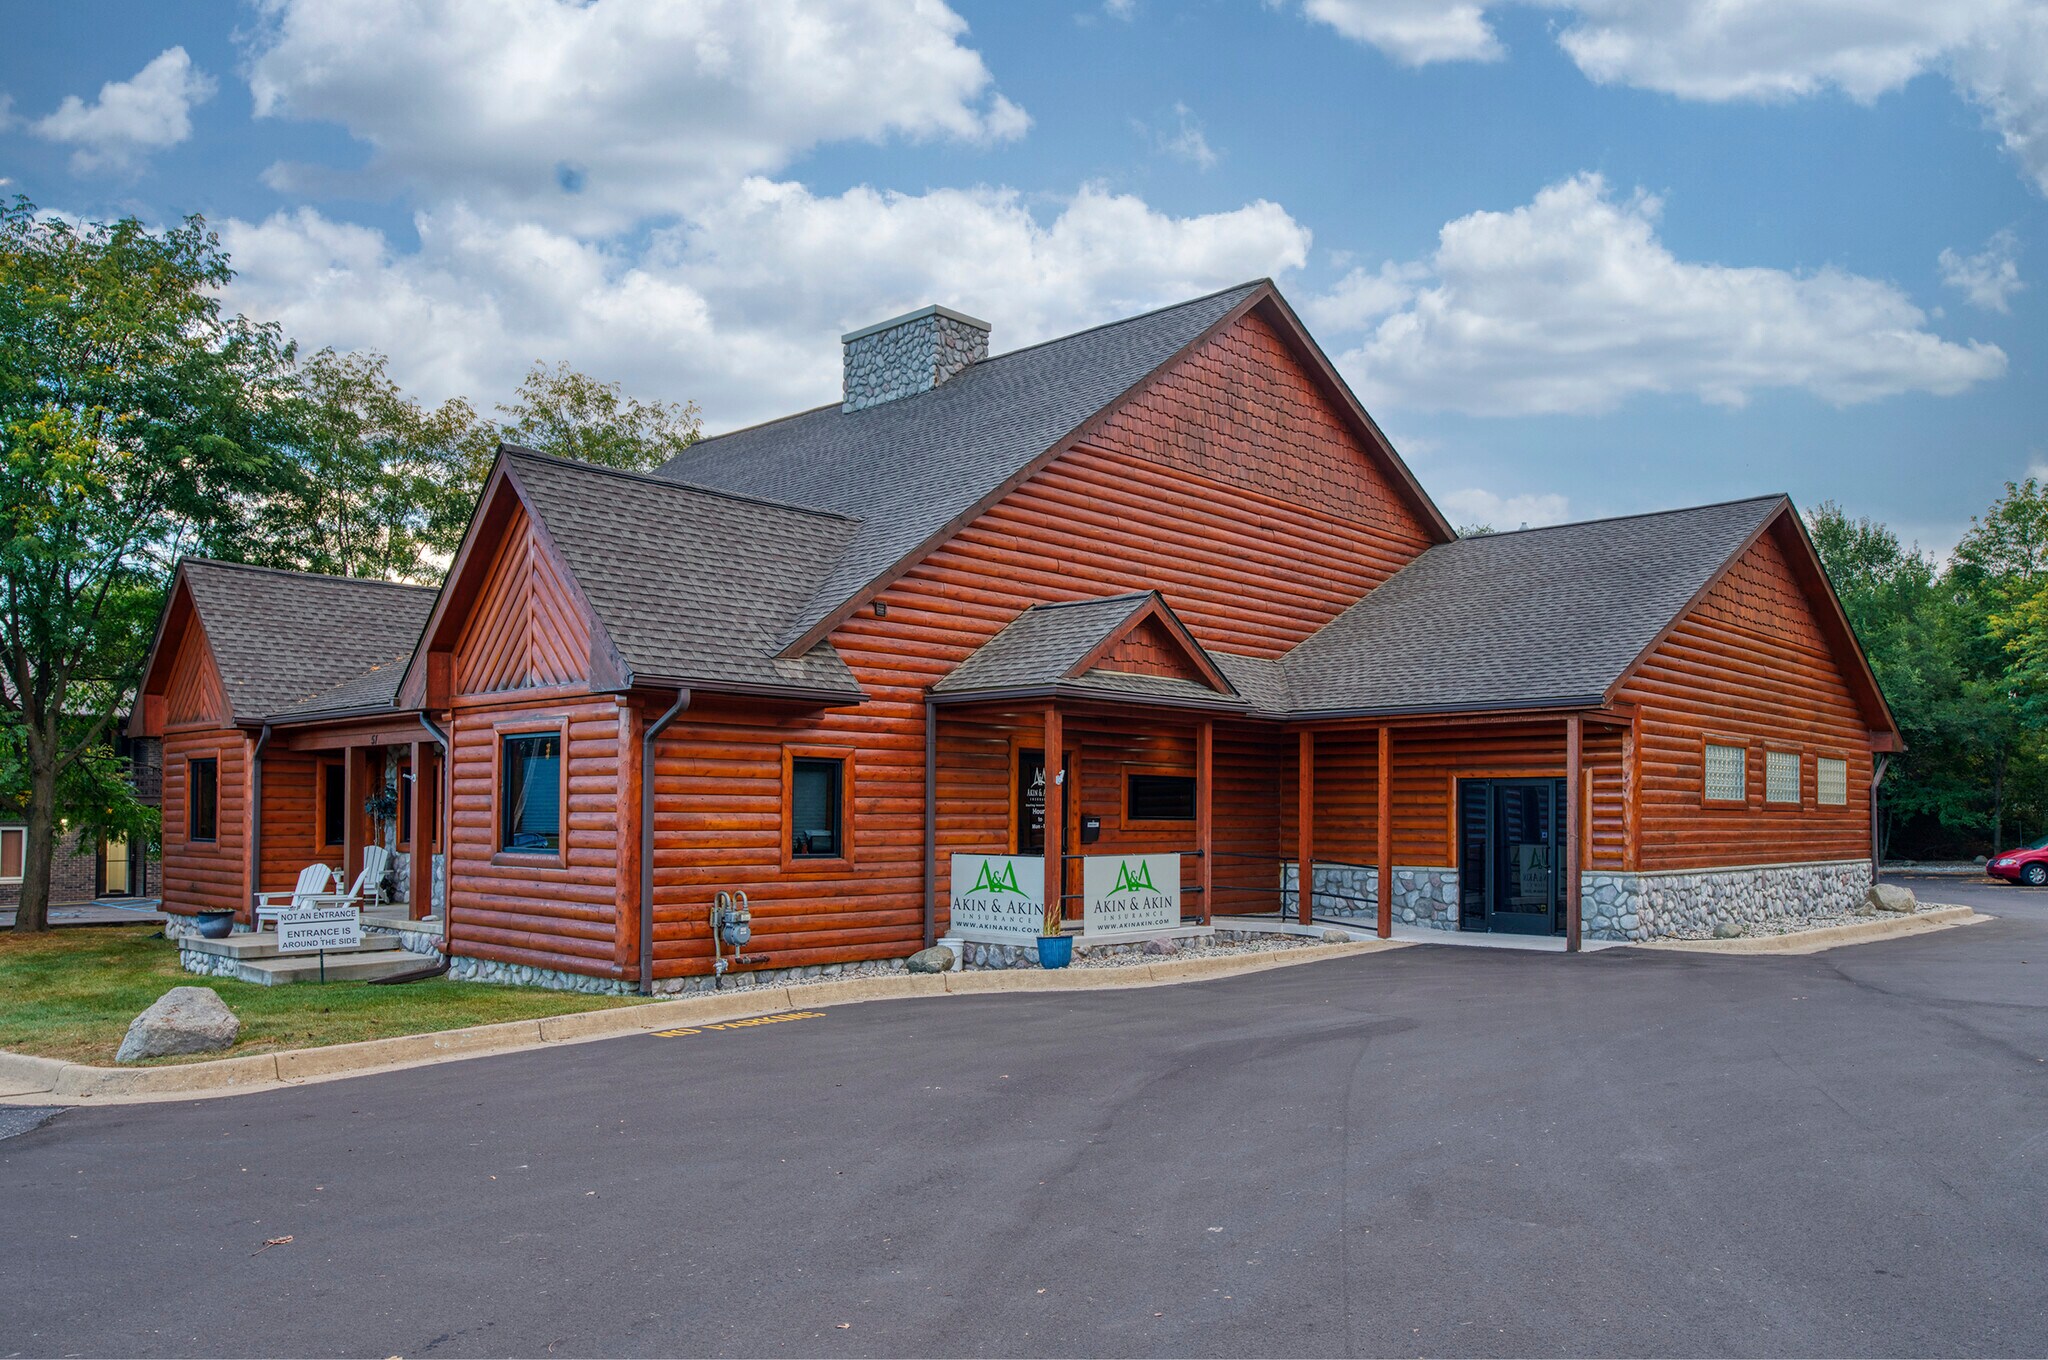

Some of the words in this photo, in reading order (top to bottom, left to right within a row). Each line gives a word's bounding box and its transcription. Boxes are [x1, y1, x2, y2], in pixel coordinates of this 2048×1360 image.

[952, 897, 987, 912] AKIN
[991, 898, 1002, 914] &
[1006, 900, 1044, 915] AKIN
[1093, 900, 1126, 914] AKIN
[1129, 896, 1140, 911] &
[1142, 896, 1173, 910] AKIN
[281, 913, 300, 921] NOT
[300, 912, 312, 920] AN
[313, 909, 357, 919] ENTRANCE
[962, 913, 1032, 924] INSURANCE
[1103, 910, 1164, 922] INSURANCE
[955, 920, 1041, 933] WWW.AKINAKIN.COM
[1097, 918, 1170, 931] WWW.AKINAKIN.COM
[287, 927, 340, 939] ENTRANCE
[342, 926, 352, 935] IS
[282, 940, 319, 949] AROUND
[320, 938, 337, 946] THE
[338, 936, 358, 945] SIDE
[649, 1027, 703, 1038] NO
[701, 1011, 828, 1031] PARKING
